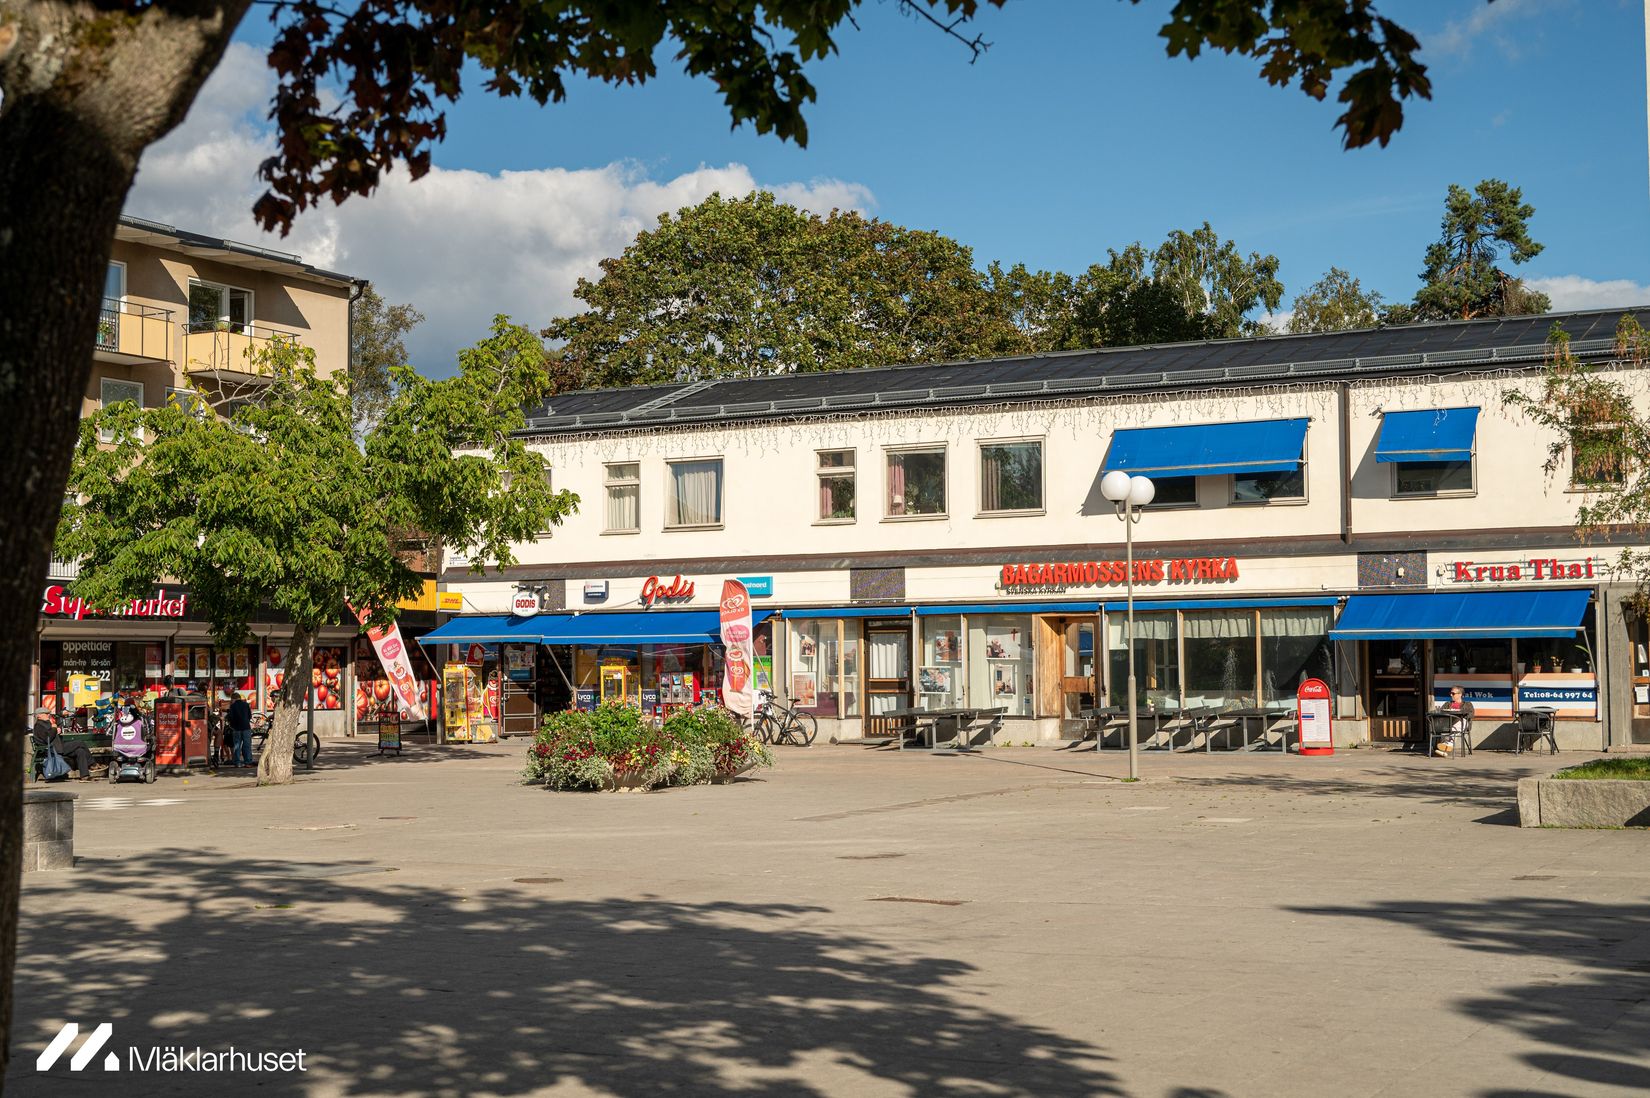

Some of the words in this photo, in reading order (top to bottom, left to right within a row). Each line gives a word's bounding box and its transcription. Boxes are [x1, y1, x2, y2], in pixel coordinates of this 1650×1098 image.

[1002, 559, 1165, 585] BAGARMOSSENS
[1171, 557, 1240, 581] KYRKA
[1454, 561, 1521, 581] Krua
[1528, 557, 1594, 580] Thai
[641, 574, 695, 605] Godis
[515, 599, 536, 609] GODIS
[642, 693, 656, 701] Lyca
[1582, 691, 1593, 699] 64
